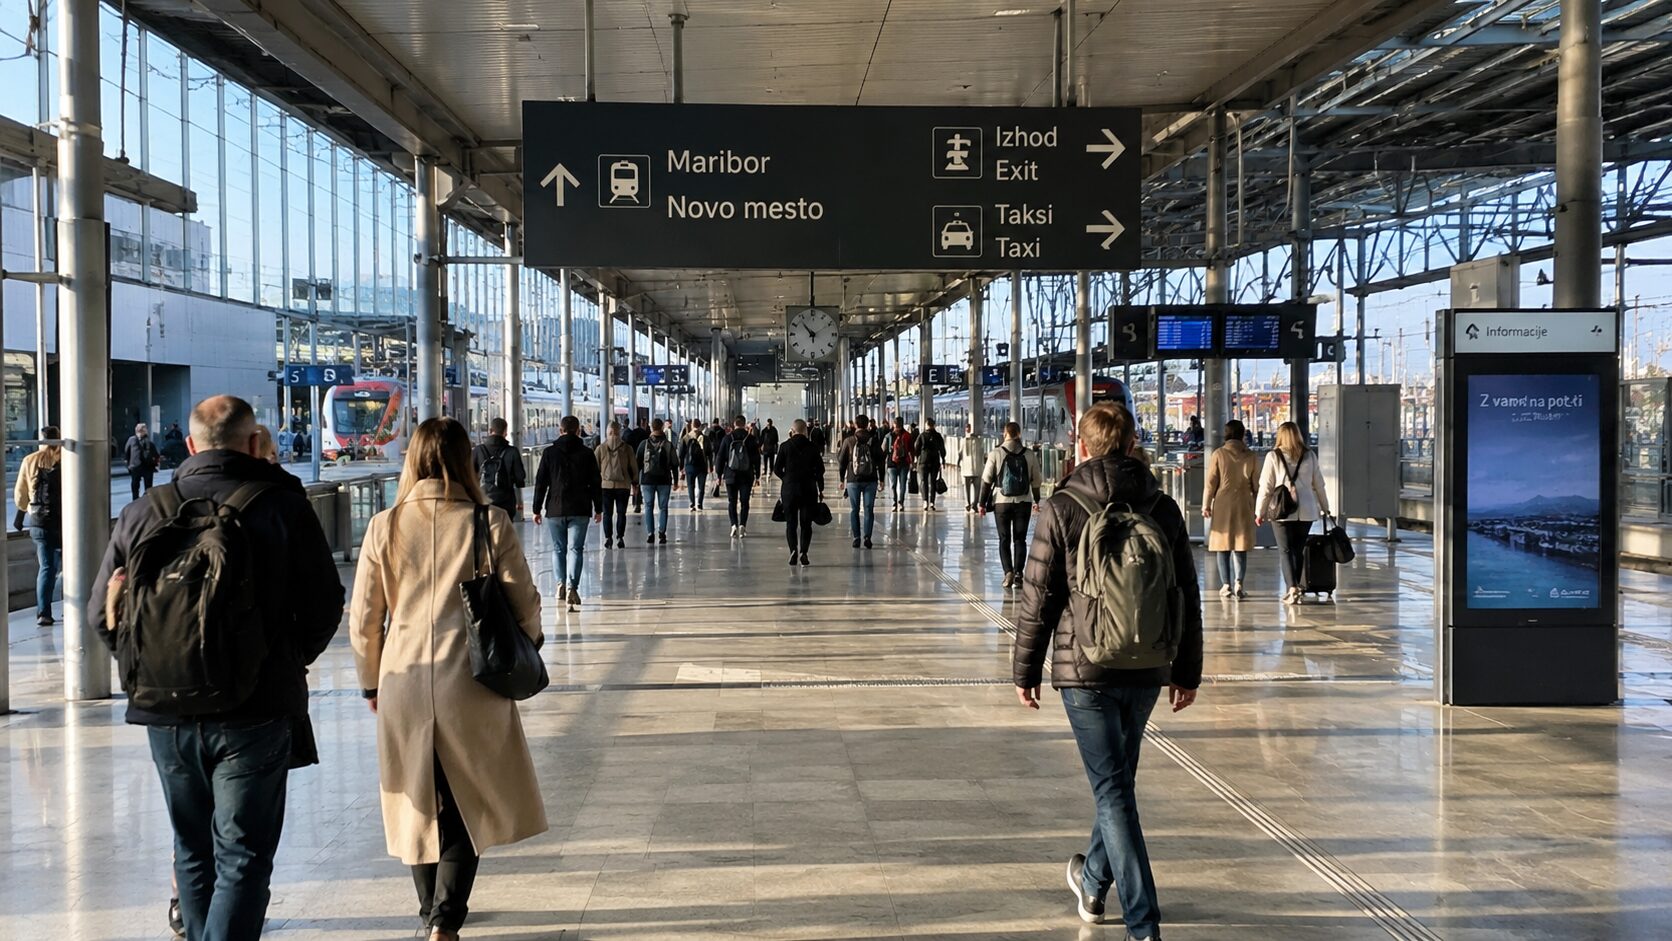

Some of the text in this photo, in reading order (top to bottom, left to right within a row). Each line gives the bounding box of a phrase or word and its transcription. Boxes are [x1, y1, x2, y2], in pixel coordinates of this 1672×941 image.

[996, 125, 1058, 147] Izhod
[668, 149, 771, 174] Maribor
[996, 159, 1039, 181] Exit
[667, 195, 824, 220] Novo mesto
[995, 203, 1053, 225] Taksi
[995, 237, 1040, 258] Taxi
[1486, 325, 1548, 340] Informacije
[1480, 393, 1490, 407] Z
[1529, 398, 1545, 407] na
